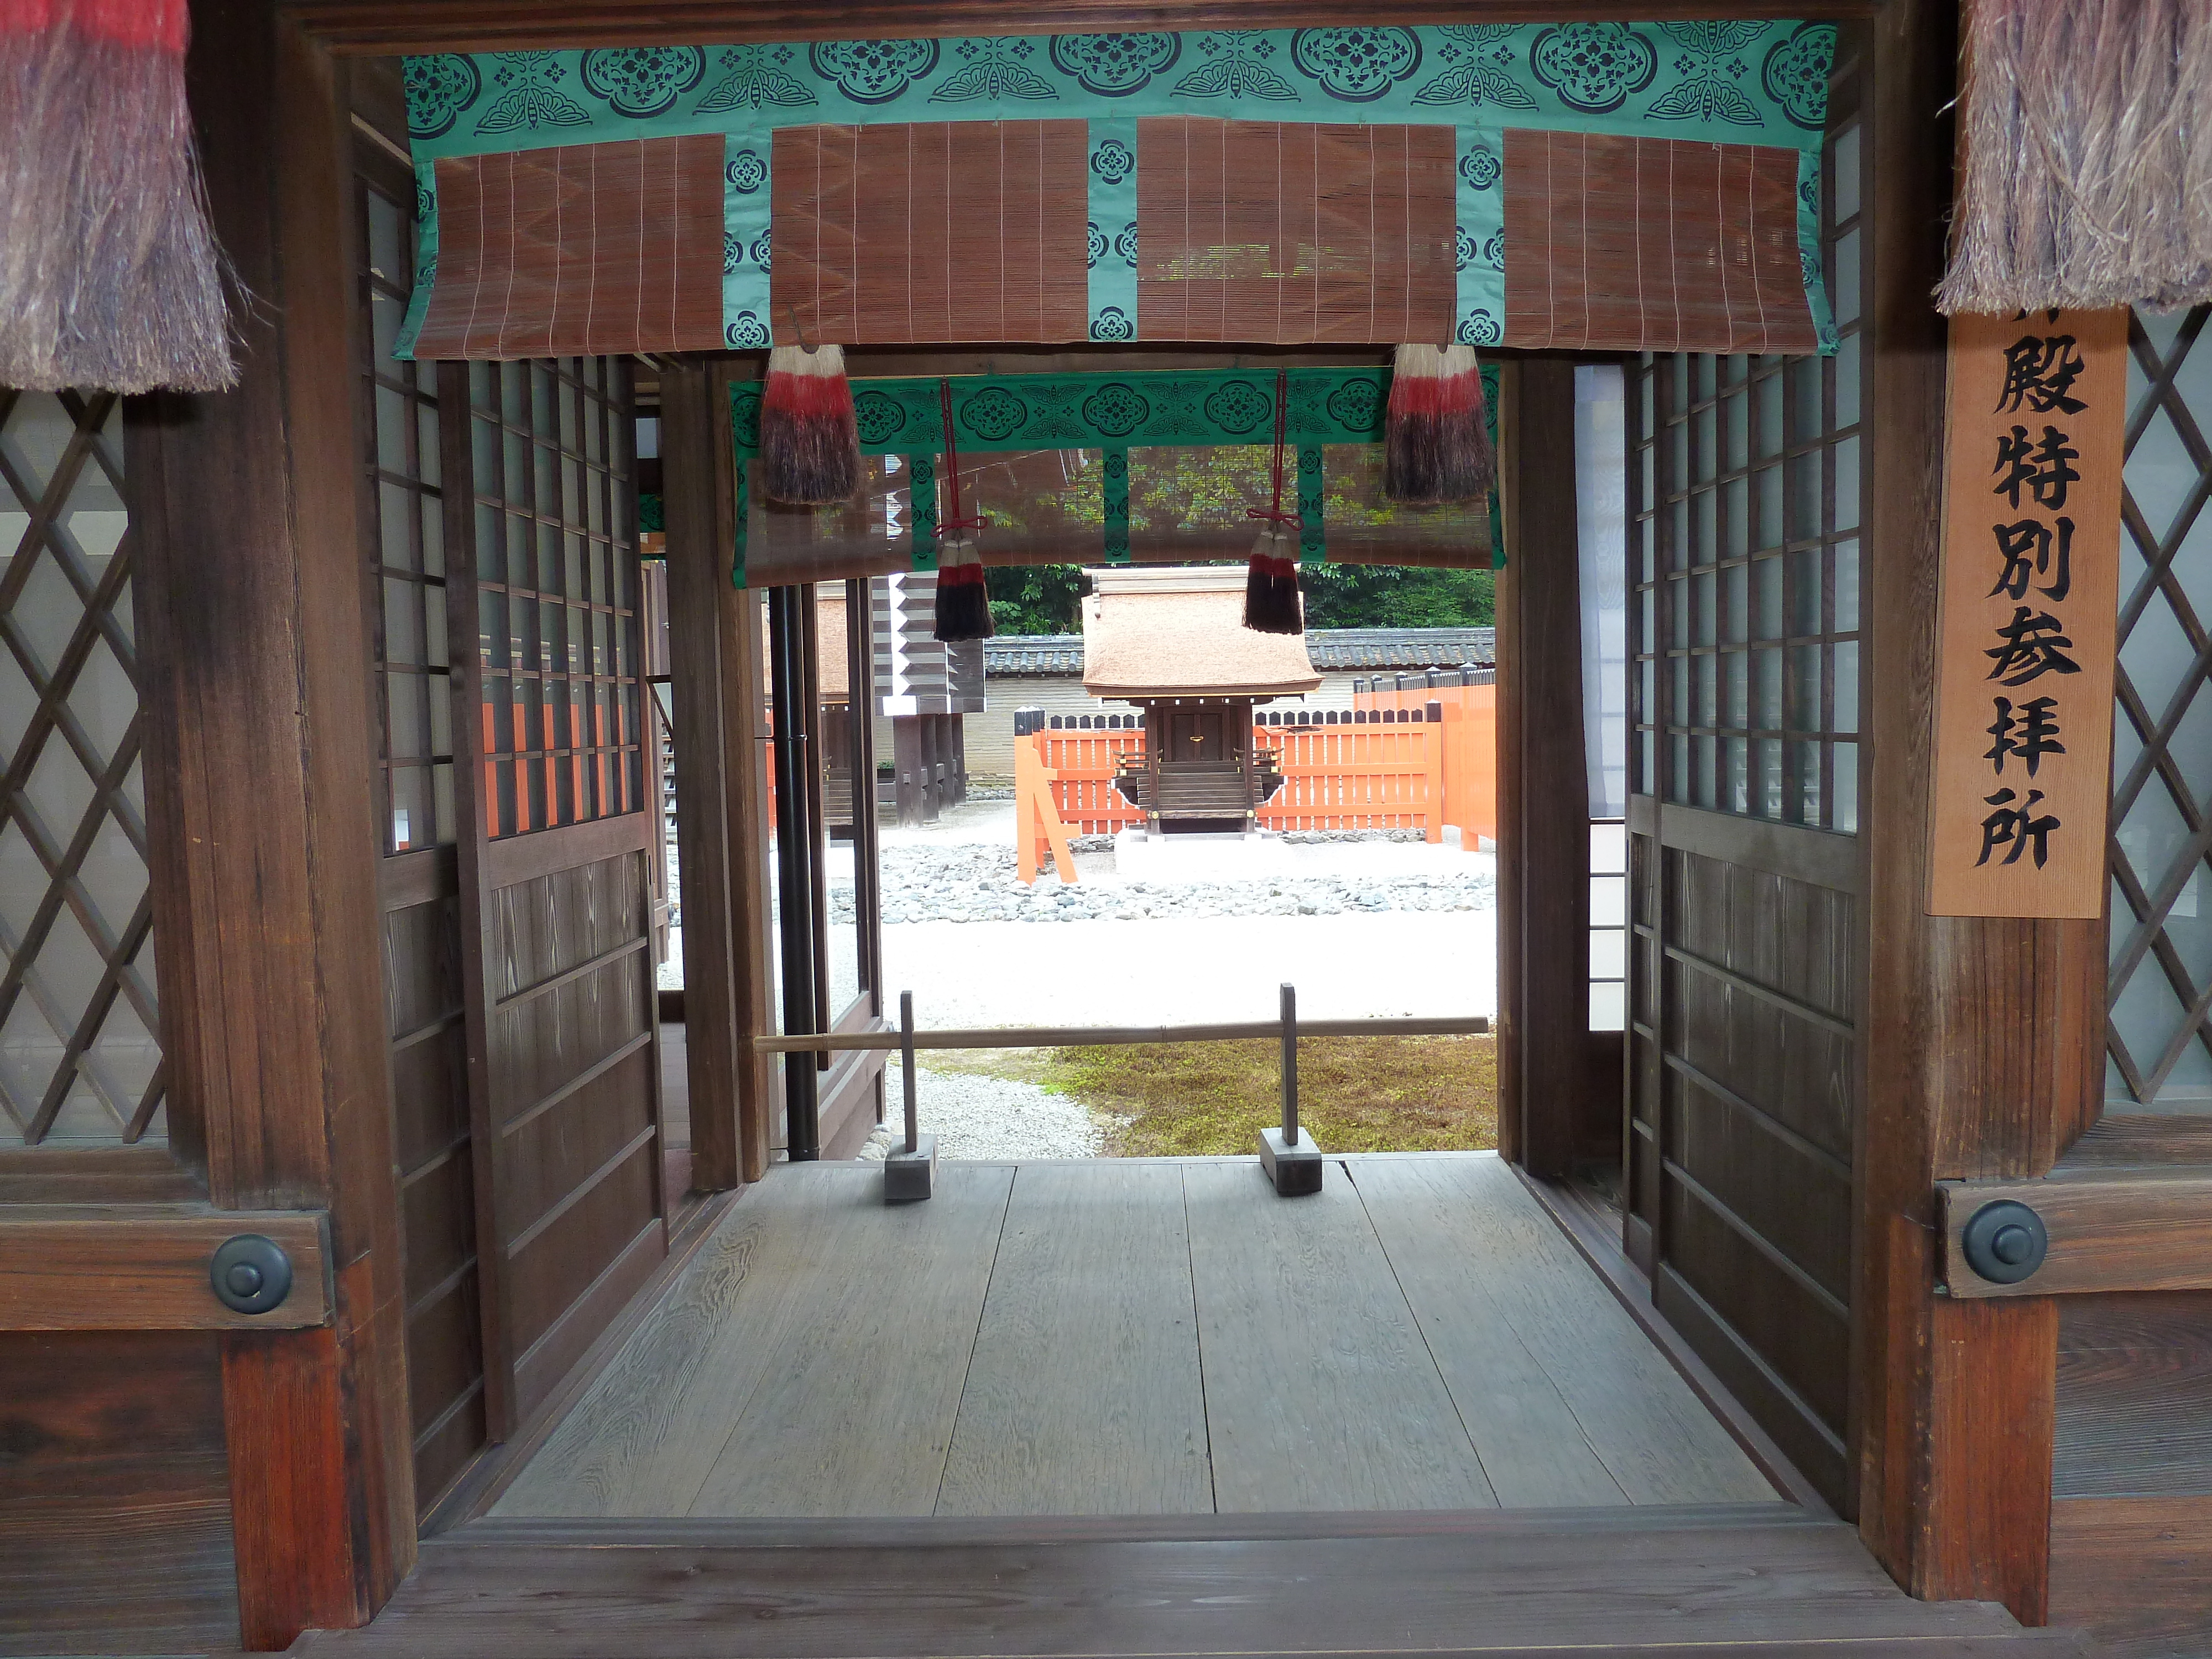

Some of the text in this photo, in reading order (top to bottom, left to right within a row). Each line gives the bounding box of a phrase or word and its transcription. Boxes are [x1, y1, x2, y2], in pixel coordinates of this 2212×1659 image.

[1974, 307, 2089, 870] 殿特別参拝所
